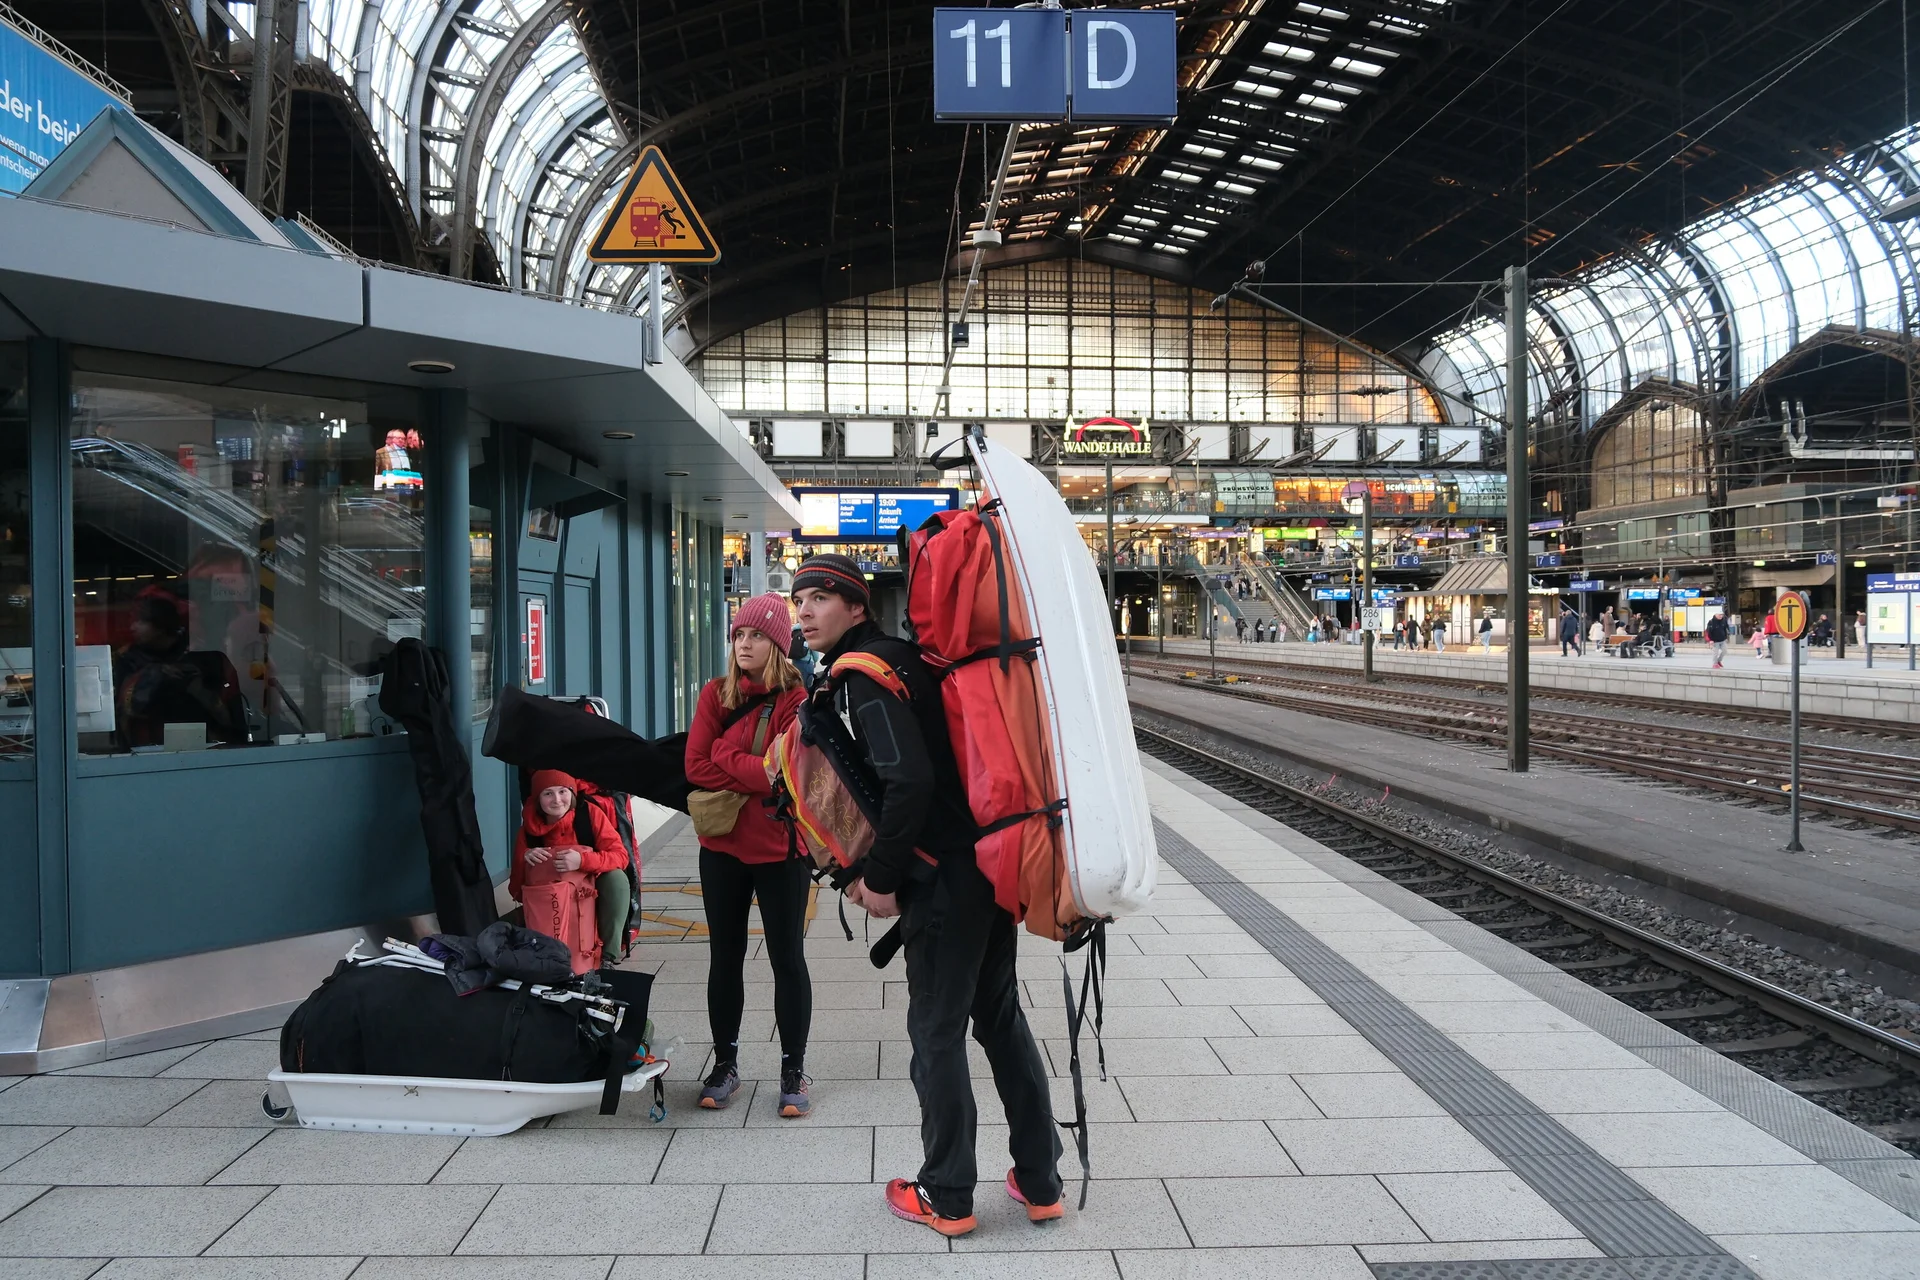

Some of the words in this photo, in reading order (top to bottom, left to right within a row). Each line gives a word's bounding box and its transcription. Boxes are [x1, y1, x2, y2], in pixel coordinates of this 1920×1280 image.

[950, 19, 1011, 88] 11
[1087, 20, 1137, 89] D
[1063, 441, 1152, 453] WANDELHALLE
[879, 507, 902, 515] Ankunft
[879, 516, 899, 524] Arrival
[1402, 556, 1408, 564] E
[1413, 556, 1419, 564] 8
[1538, 556, 1544, 565] 7
[1550, 556, 1556, 564] E
[1821, 554, 1828, 563] D
[858, 562, 865, 570] 11
[872, 562, 878, 571] E
[1362, 608, 1379, 618] 286
[1367, 619, 1374, 628] 6
